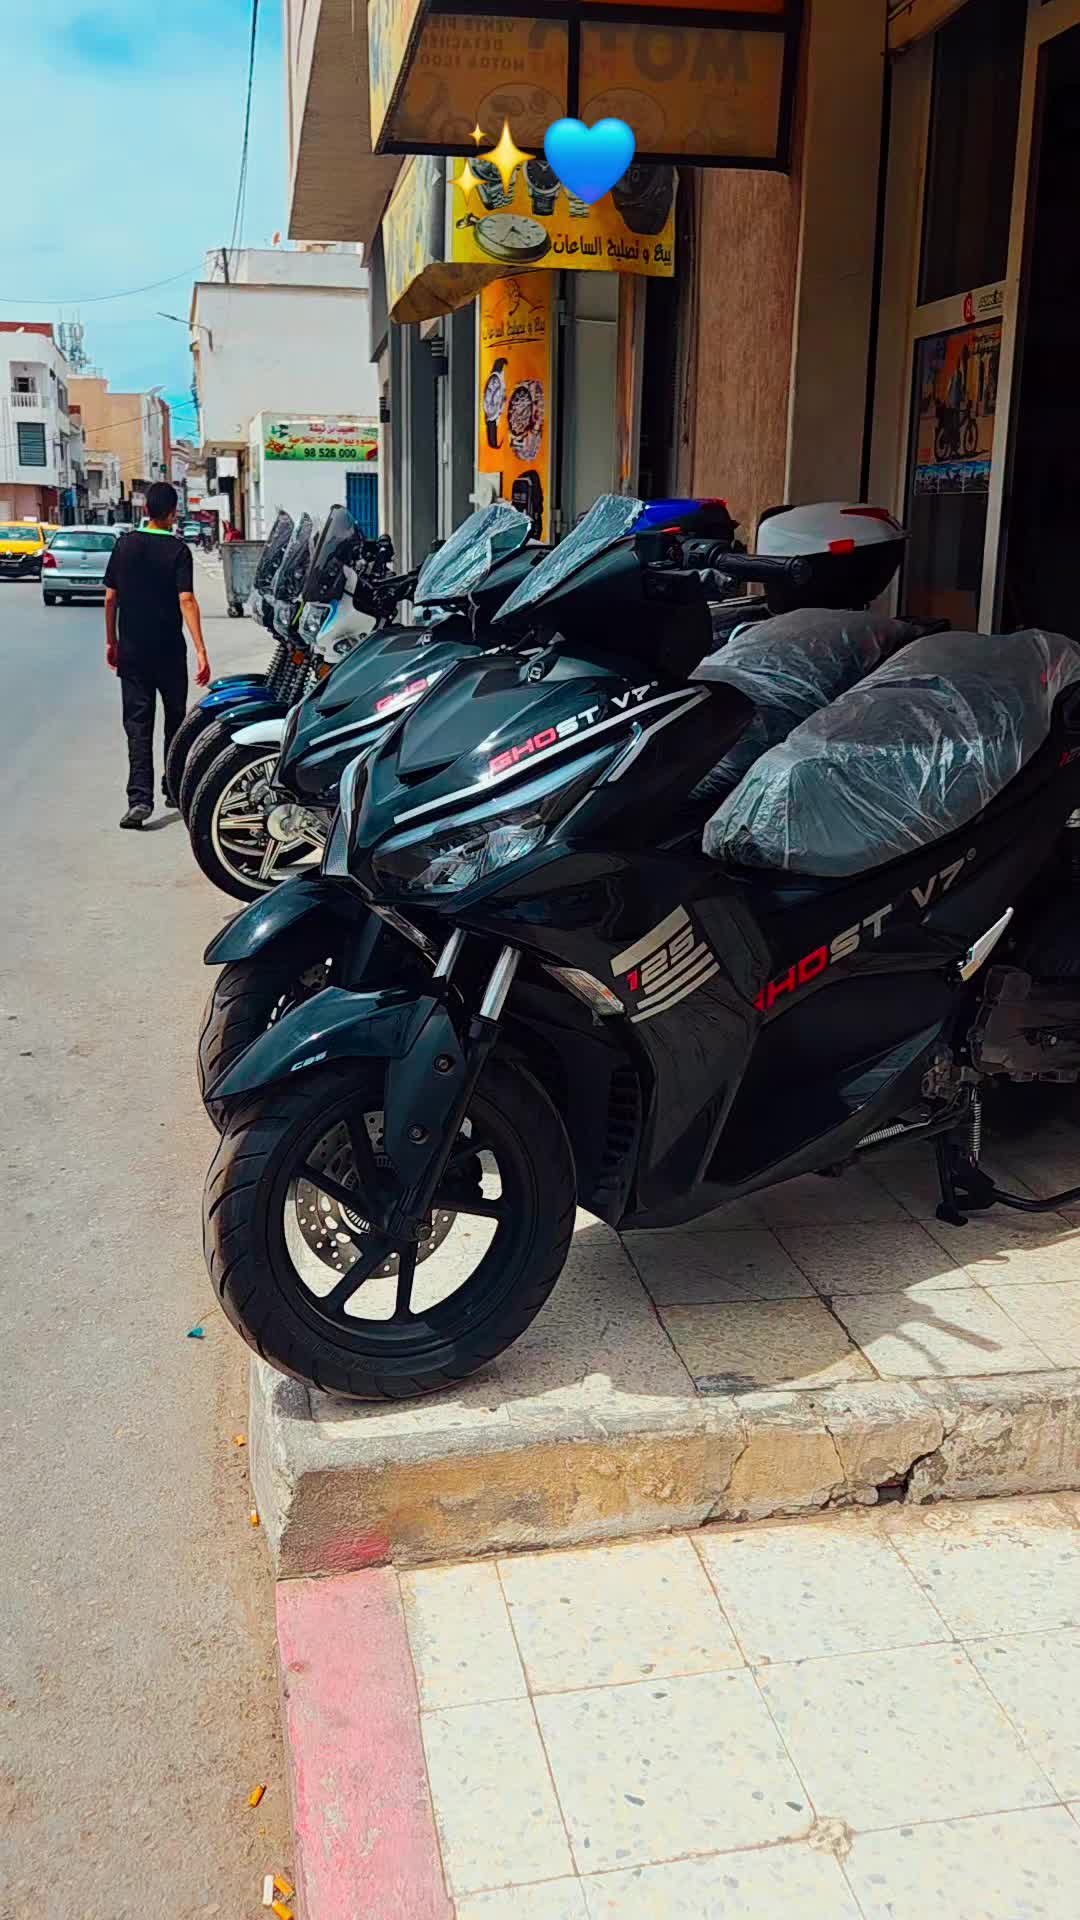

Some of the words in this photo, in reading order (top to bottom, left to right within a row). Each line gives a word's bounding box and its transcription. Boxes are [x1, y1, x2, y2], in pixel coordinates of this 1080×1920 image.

[553, 233, 603, 256] الساعات
[607, 238, 639, 261] تصليح
[643, 248, 650, 264] و
[654, 244, 672, 266] بيع
[304, 448, 316, 458] 98
[338, 448, 357, 458] 000
[490, 705, 599, 775] GHOST
[626, 923, 695, 992] 125
